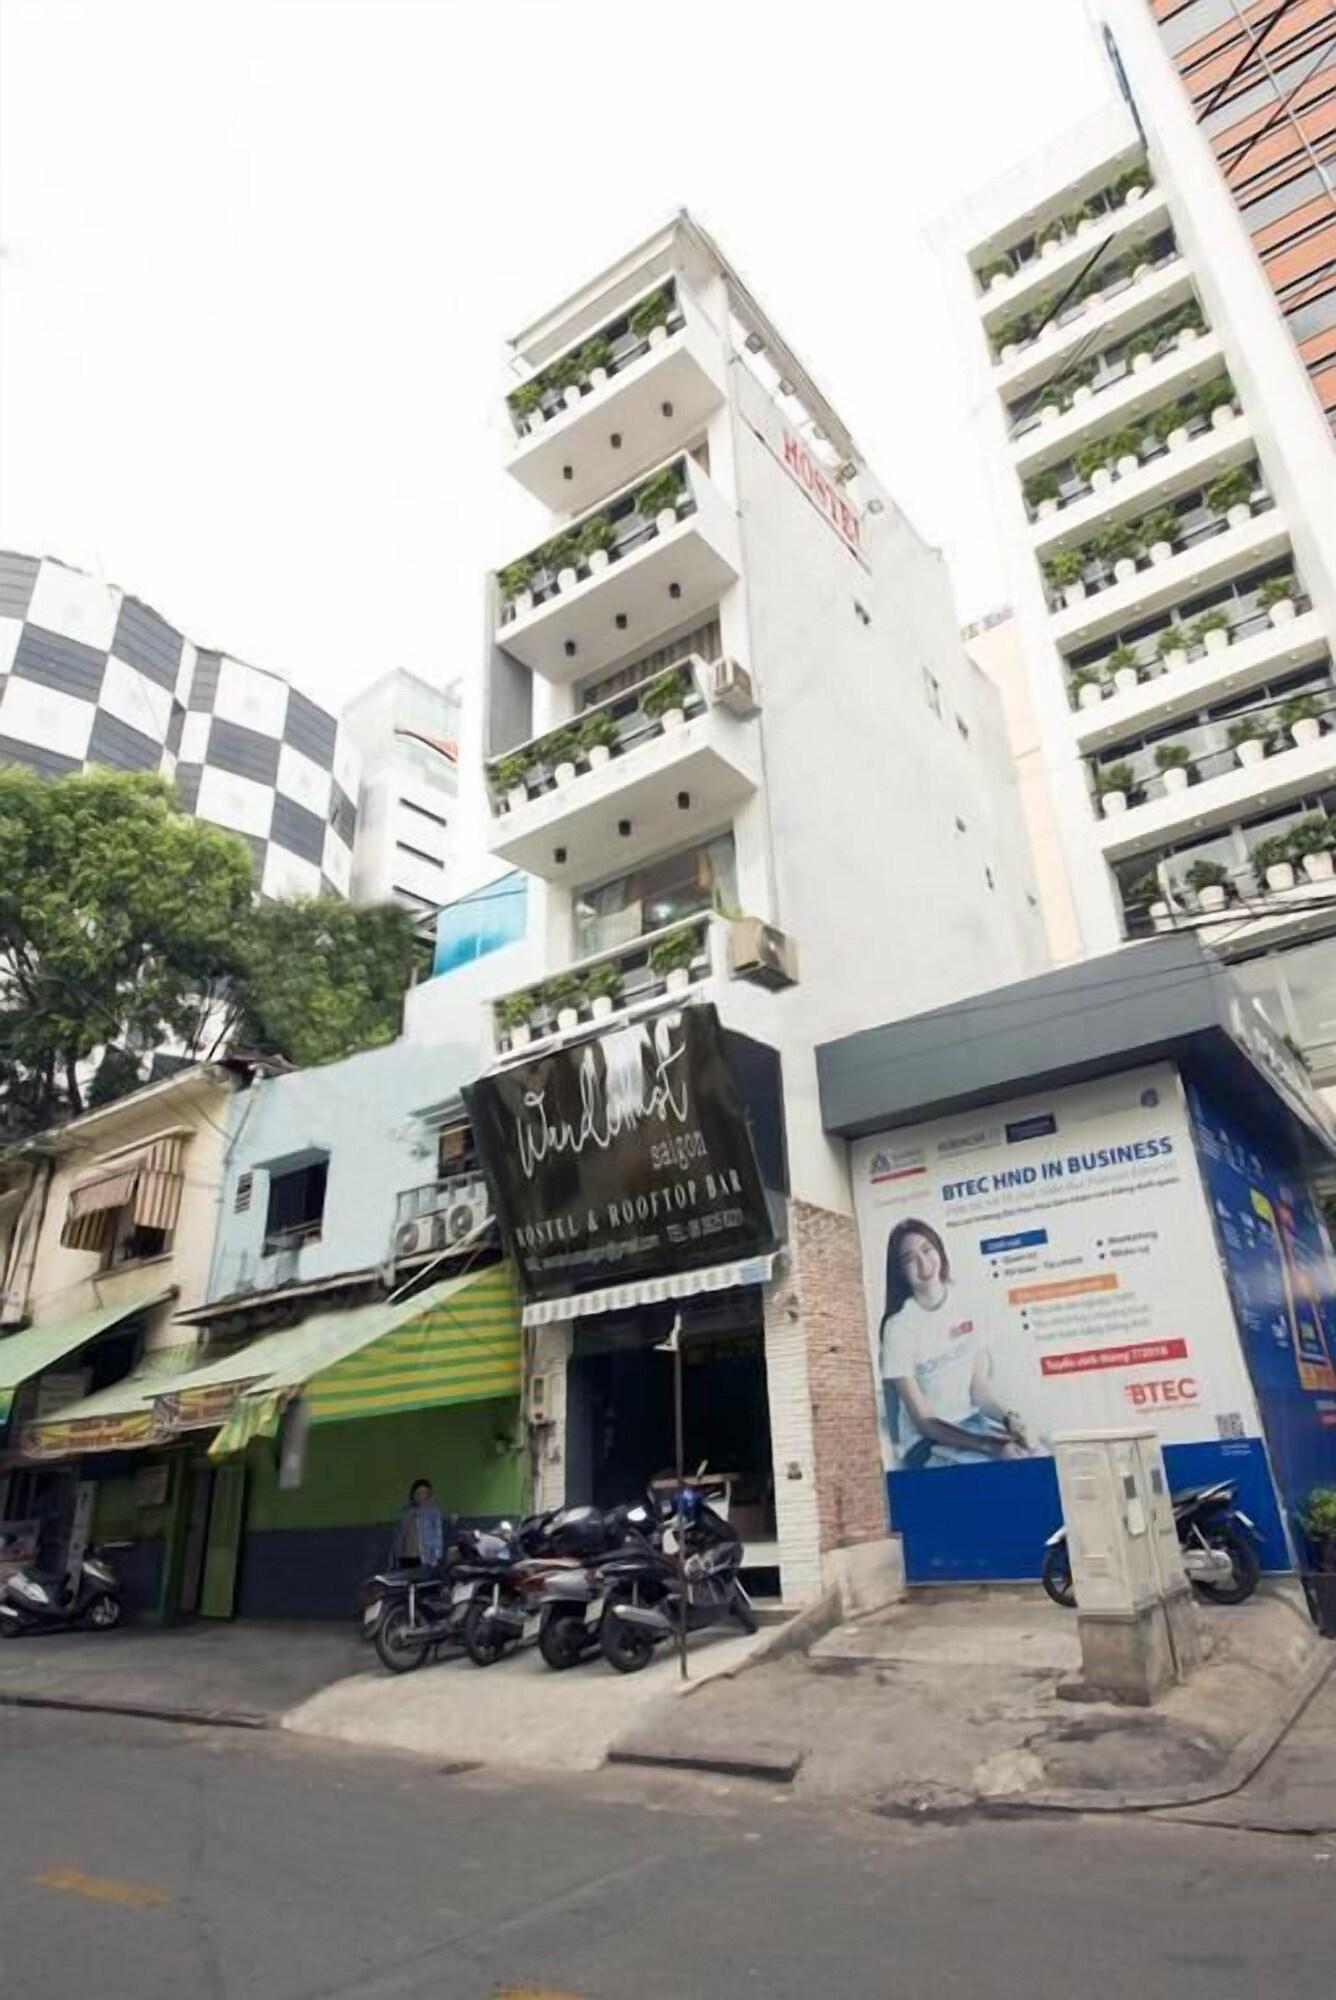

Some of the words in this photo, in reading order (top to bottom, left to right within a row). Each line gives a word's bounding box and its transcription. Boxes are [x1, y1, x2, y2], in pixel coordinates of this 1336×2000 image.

[943, 1176, 989, 1201] BTEC
[993, 1167, 1037, 1190] HND
[1041, 1159, 1064, 1180] IN
[1067, 1135, 1173, 1174] BUSINESS
[516, 1215, 579, 1248] HOSTEL
[607, 1179, 697, 1228] ROOFTOP
[705, 1168, 743, 1200] BAR
[1127, 1377, 1198, 1406] BTEC
